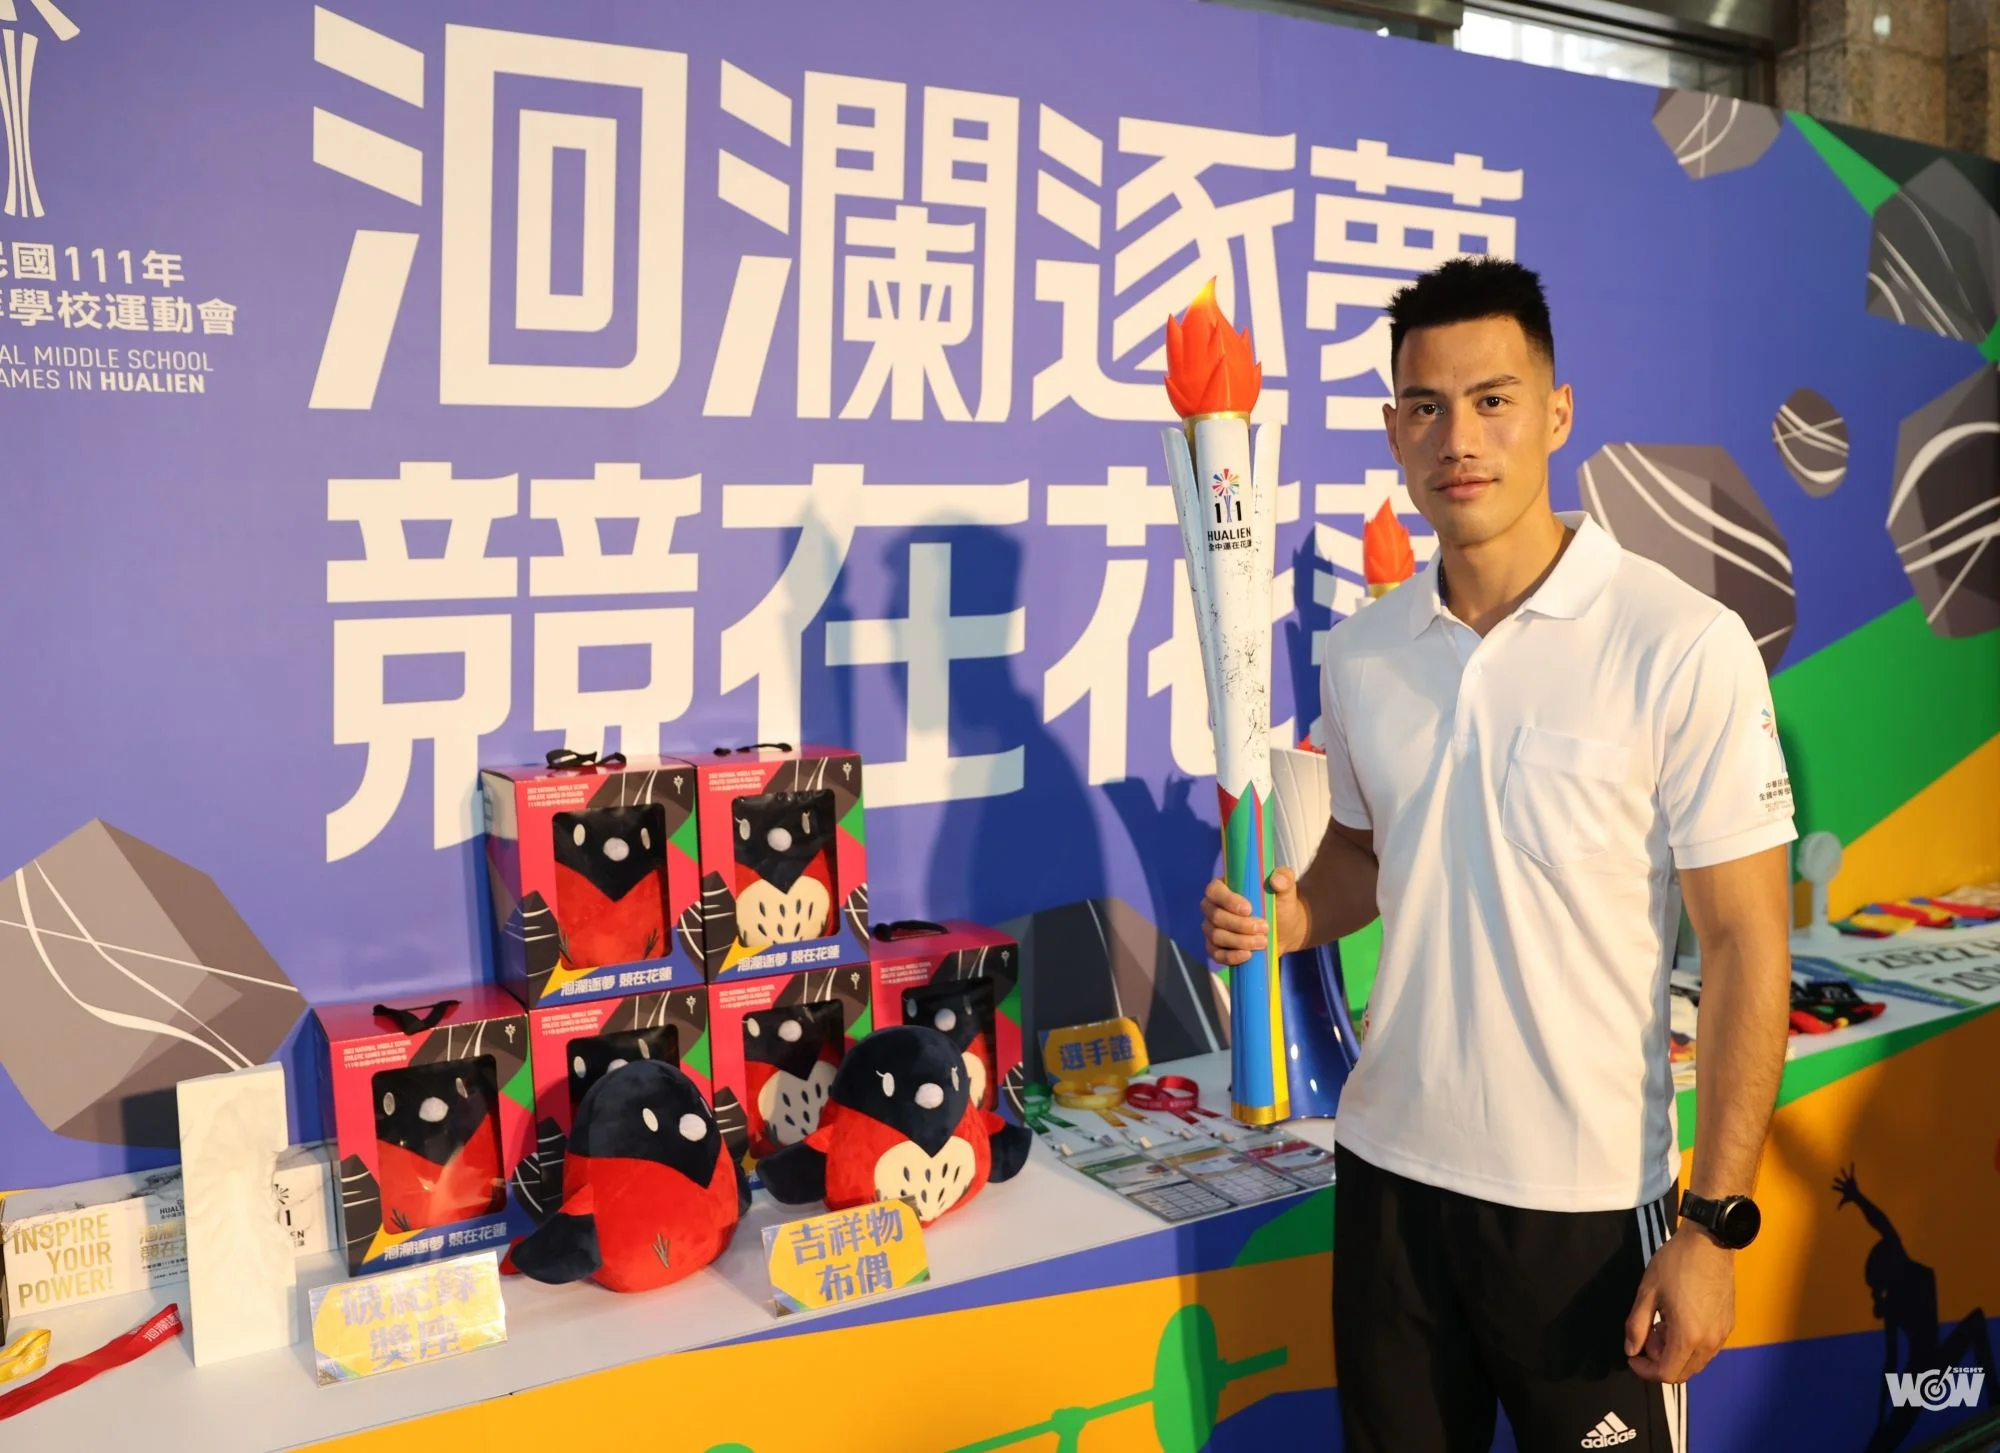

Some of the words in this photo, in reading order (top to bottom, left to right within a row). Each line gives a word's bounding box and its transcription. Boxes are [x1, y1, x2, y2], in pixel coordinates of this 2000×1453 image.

[0, 241, 185, 288] 國111年
[0, 287, 237, 336] 學校運動會
[34, 345, 120, 369] MIDDLE
[127, 349, 214, 372] SCHOOL
[69, 370, 92, 390] IN
[100, 371, 205, 394] HUALIEN
[1207, 527, 1252, 542] HUALIEN
[1058, 1032, 1136, 1072] 選手證
[12, 1213, 111, 1255] INSPIRE
[789, 1206, 904, 1266] 吉祥物
[46, 1240, 113, 1275] YOUR
[816, 1251, 894, 1302] 布偶
[18, 1266, 114, 1309] POWER!
[1580, 1428, 1637, 1449] adidas
